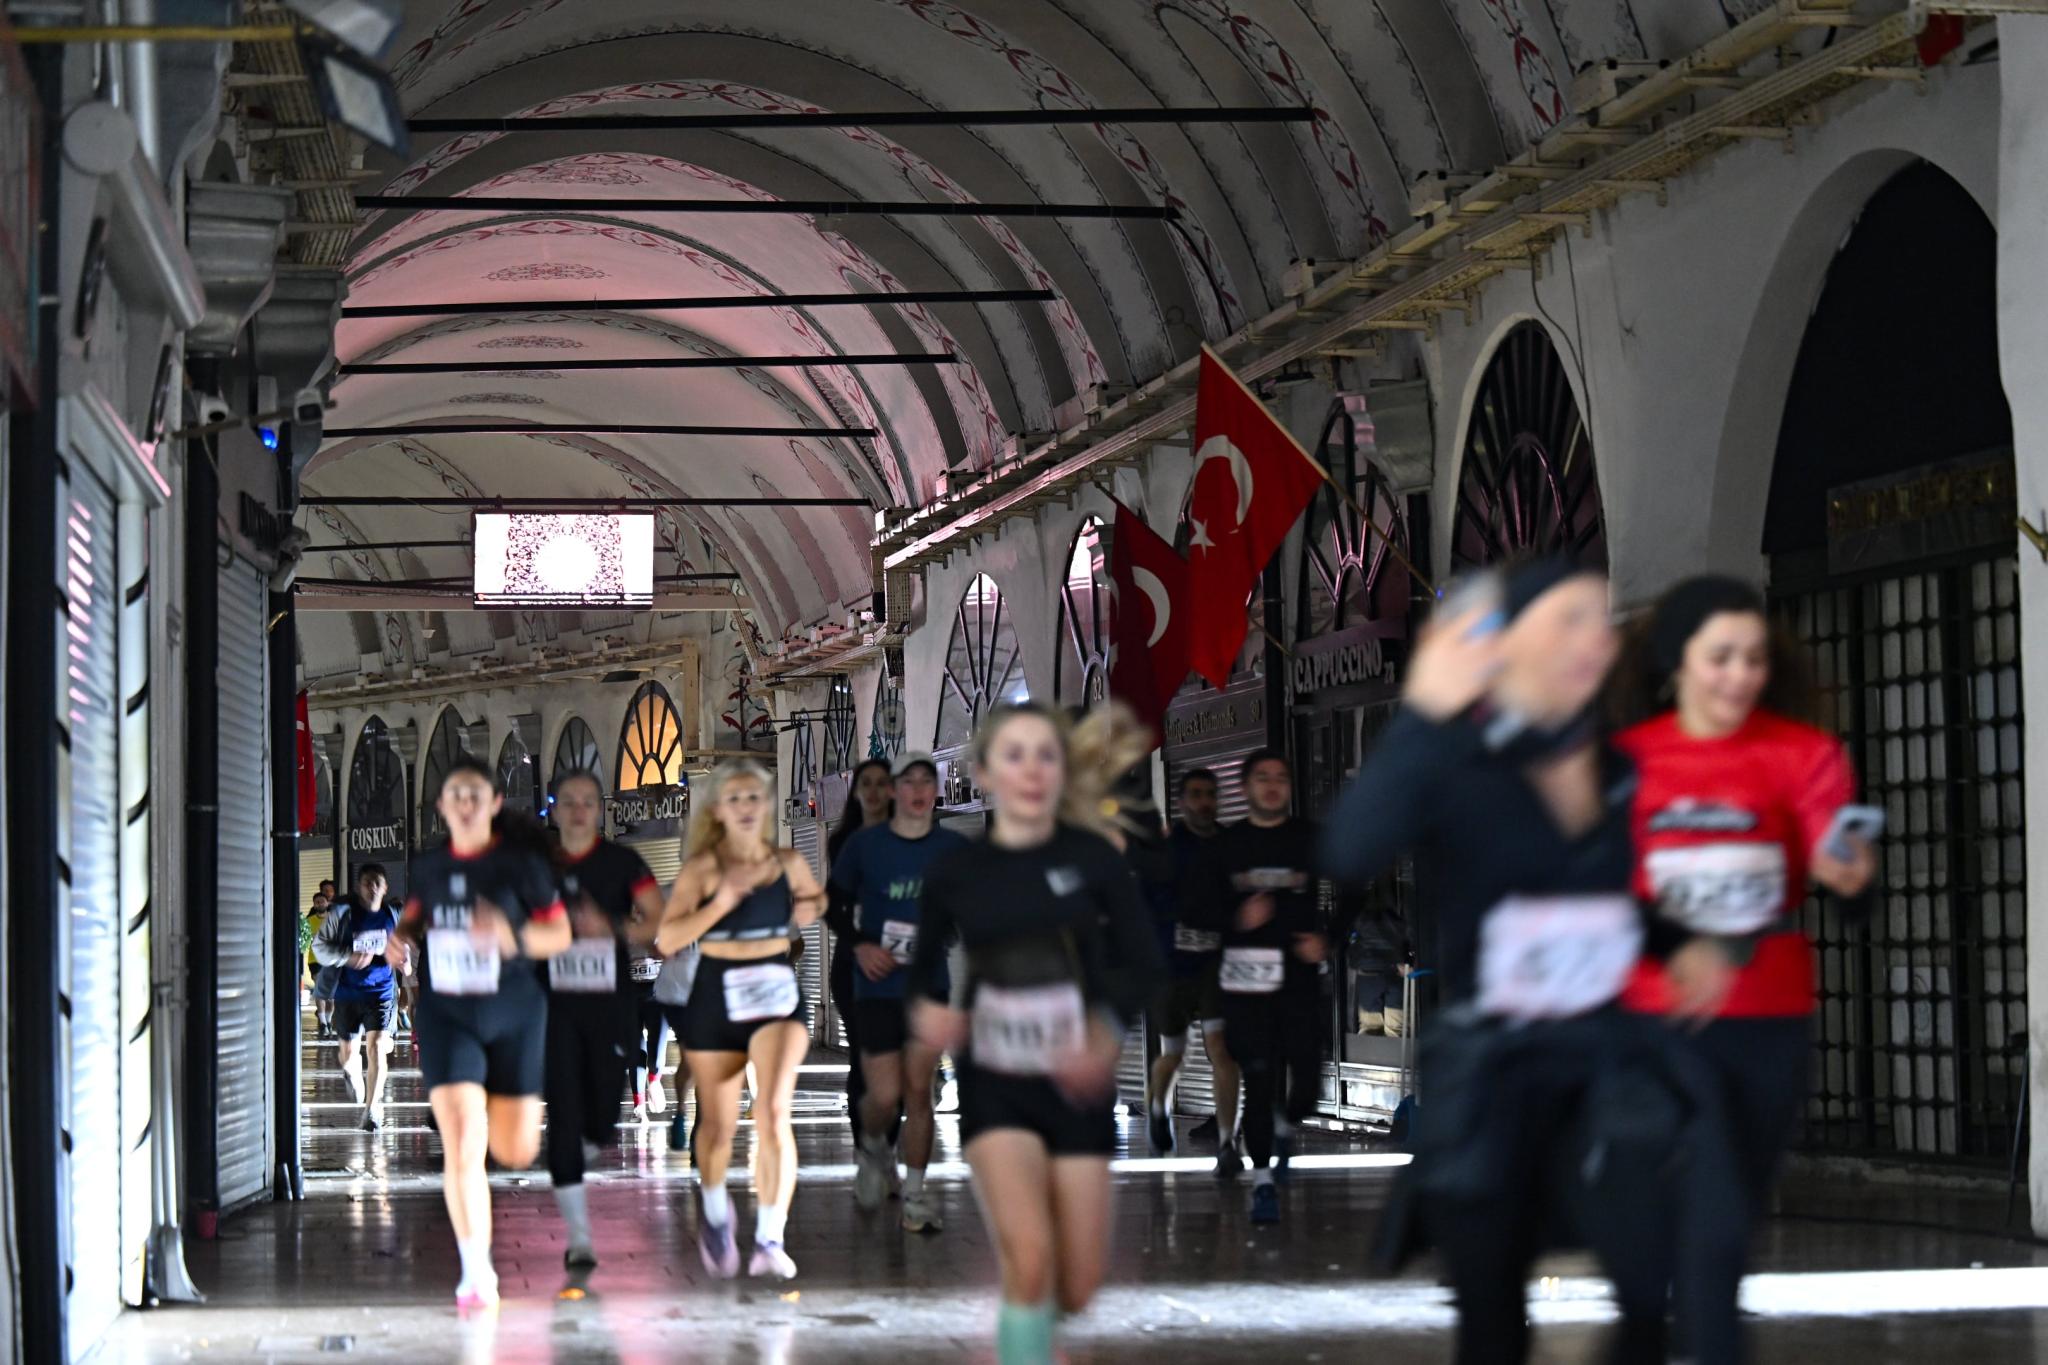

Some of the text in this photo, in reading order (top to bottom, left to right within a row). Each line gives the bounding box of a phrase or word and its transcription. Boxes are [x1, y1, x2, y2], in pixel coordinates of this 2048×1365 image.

[1295, 639, 1382, 694] CAPPUCCINO
[617, 796, 683, 823] BORSA GOLD
[351, 825, 396, 853] COŞKUN
